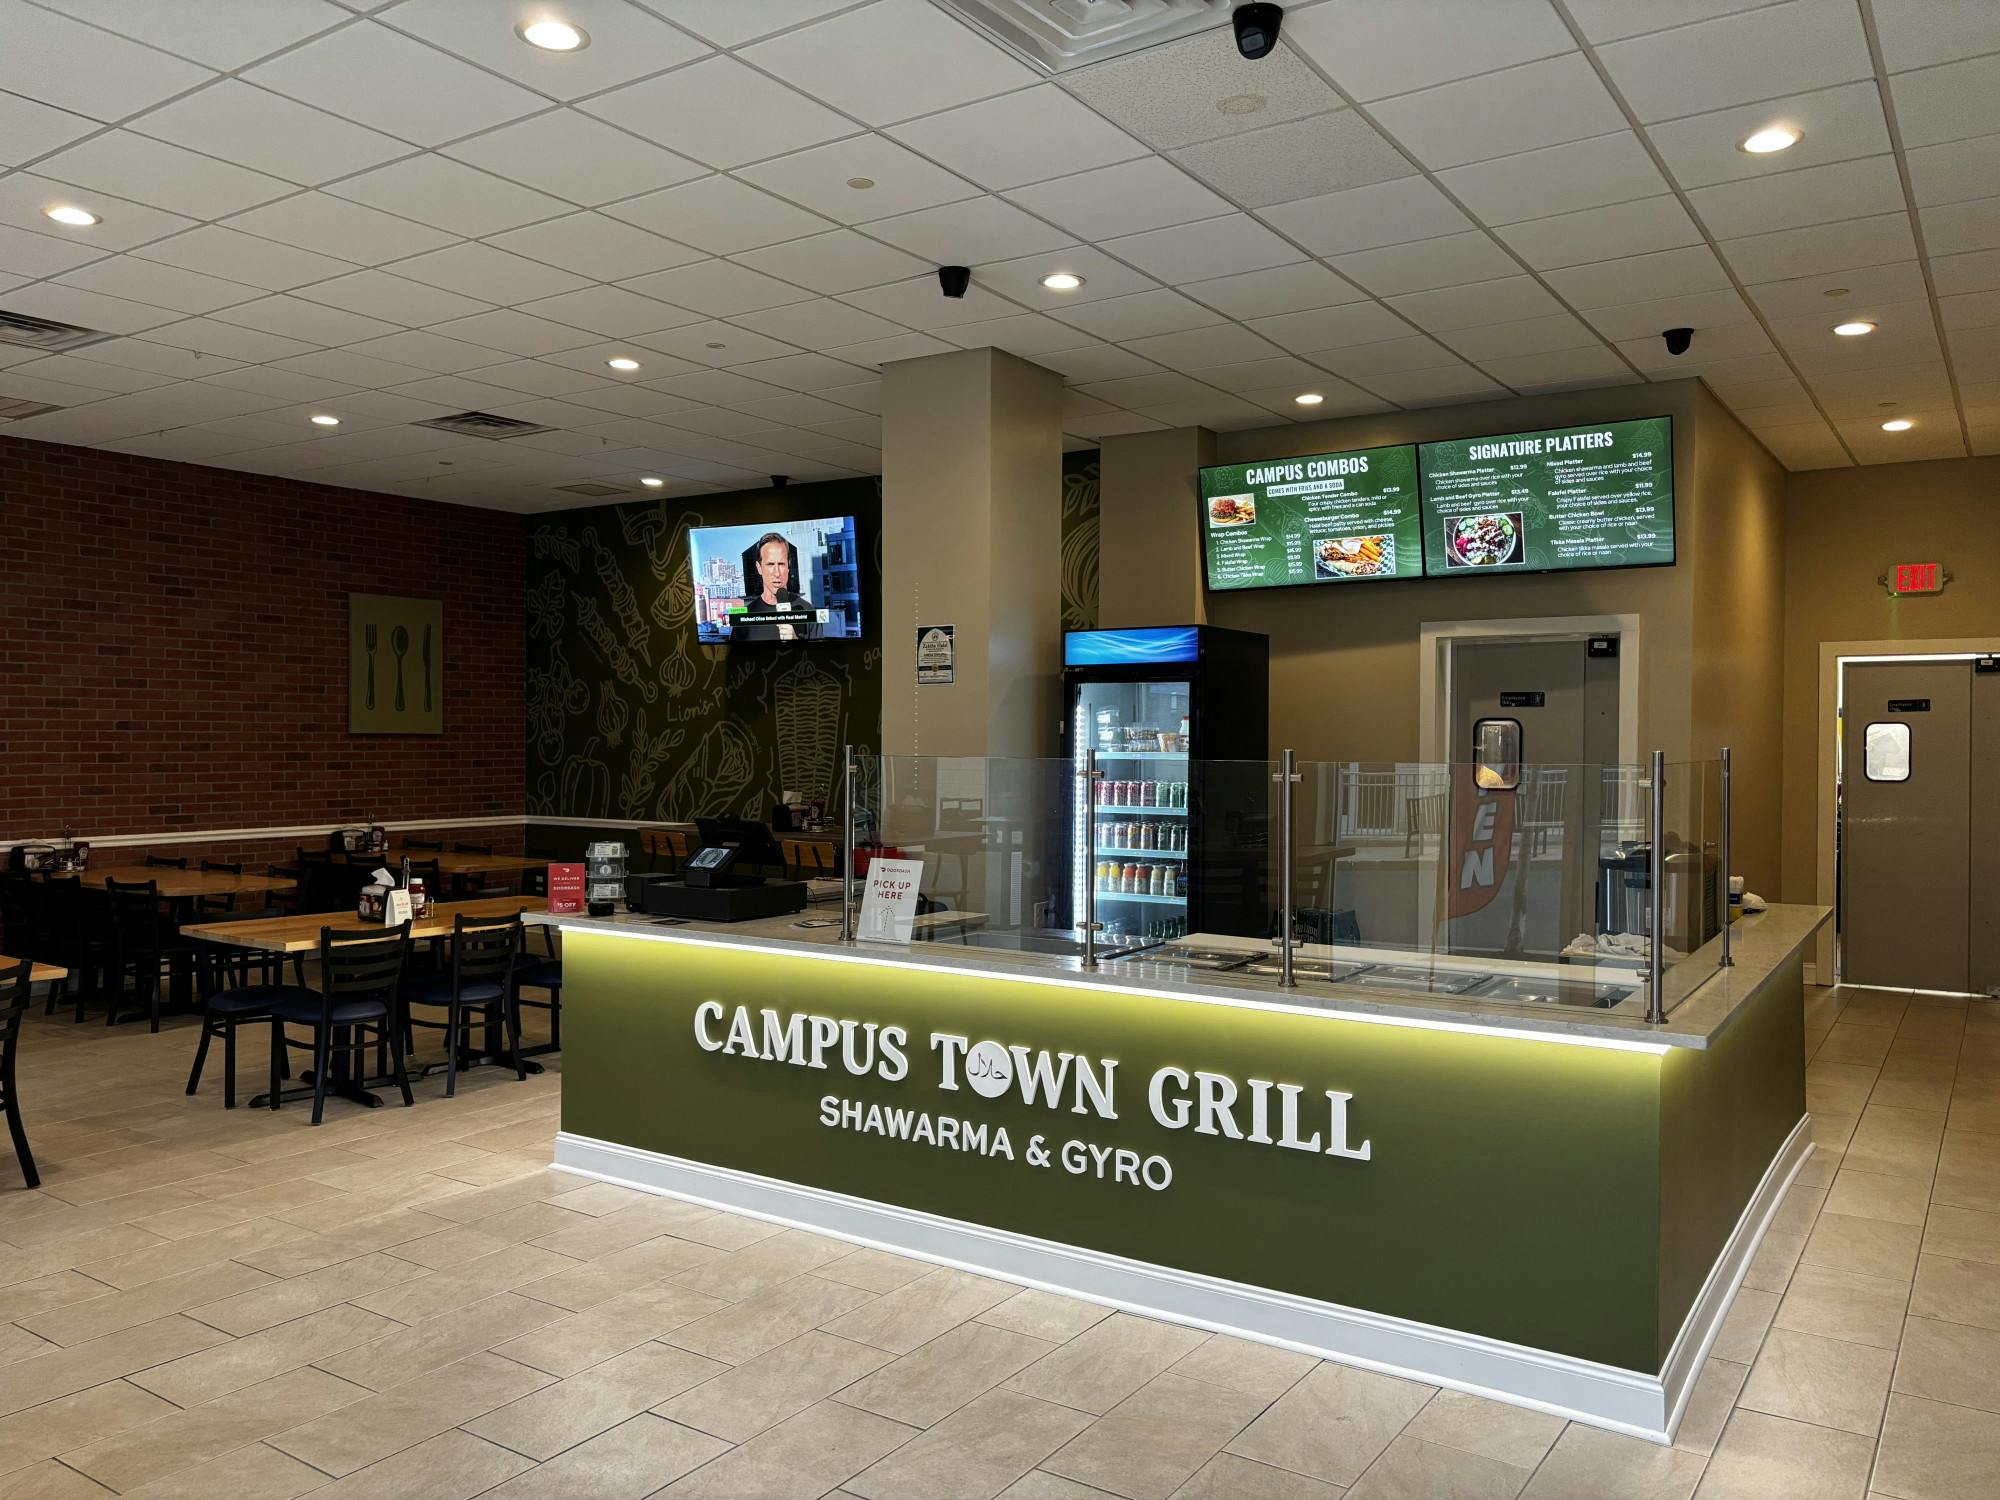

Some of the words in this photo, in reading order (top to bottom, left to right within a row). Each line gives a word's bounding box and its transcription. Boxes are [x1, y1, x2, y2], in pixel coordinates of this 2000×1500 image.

[1470, 439, 1542, 460] SIGNATURE
[1546, 431, 1614, 453] PLATTERS
[1246, 468, 1304, 485] CAMPUS
[1308, 456, 1368, 478] COMBOS
[1897, 564, 1937, 592] EXIT
[712, 659, 756, 708] Pride
[873, 880, 895, 888] PICK
[878, 891, 903, 899] HERE
[695, 1000, 909, 1081] CAMPUS
[930, 1032, 1120, 1120] TOWN
[1148, 1066, 1371, 1161] GRILL
[819, 1096, 1014, 1161] SHAWARMA
[1025, 1135, 1052, 1167] &
[1061, 1139, 1173, 1191] GYRO
